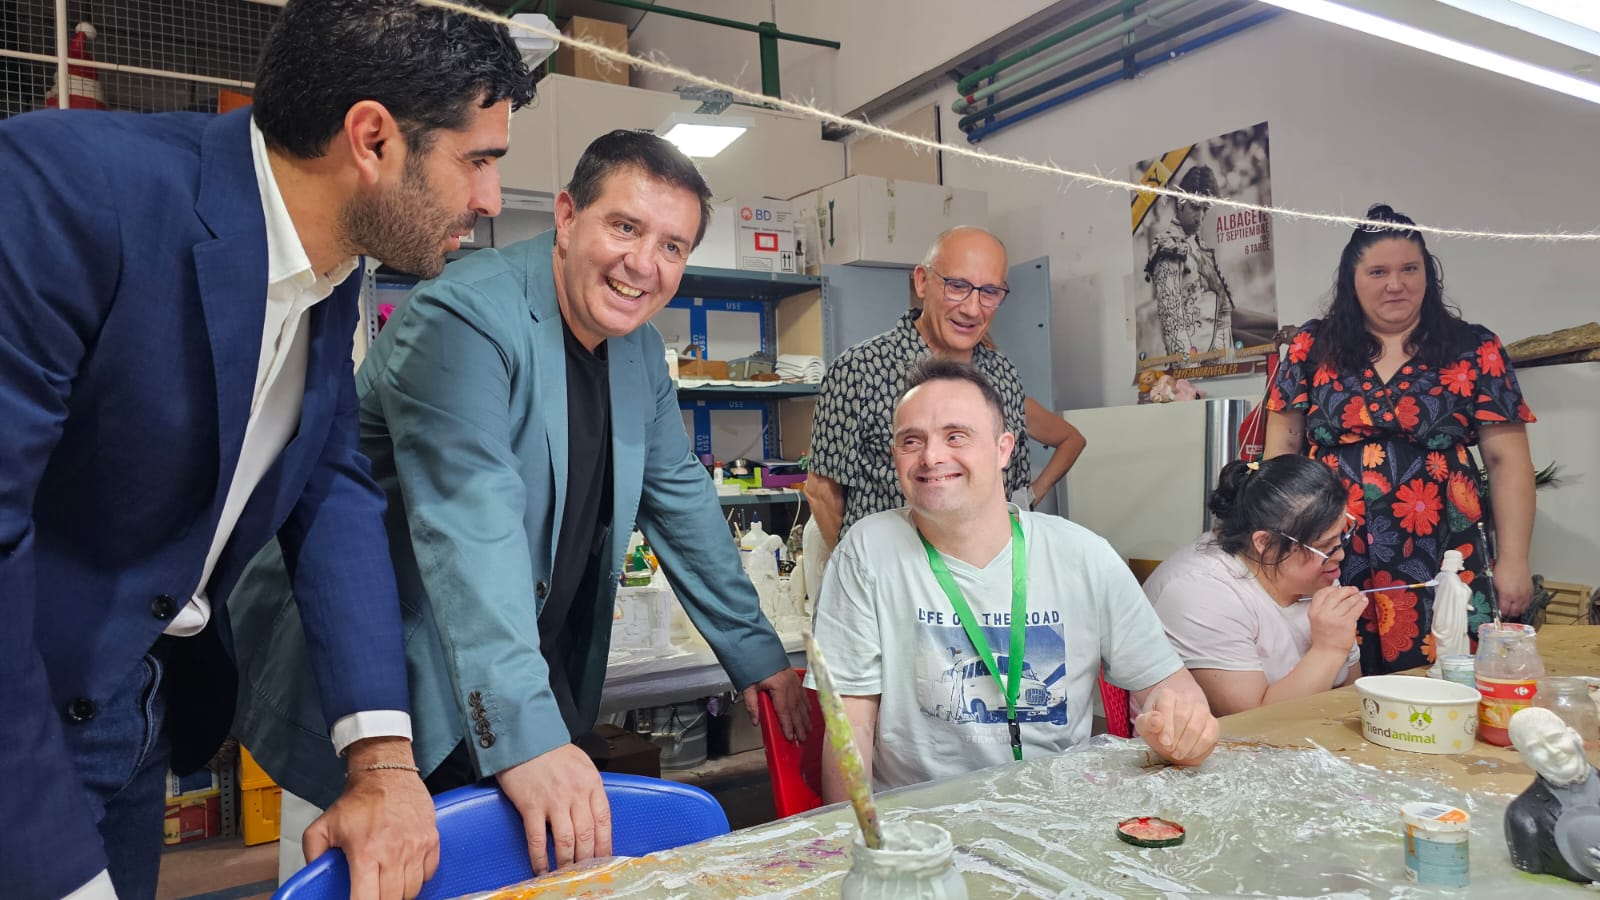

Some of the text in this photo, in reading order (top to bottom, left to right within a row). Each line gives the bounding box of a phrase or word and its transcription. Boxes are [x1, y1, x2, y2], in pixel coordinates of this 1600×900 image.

[755, 208, 772, 222] BD
[1226, 222, 1270, 242] SEPTIEMBRE
[982, 612, 1011, 626] THE
[1366, 721, 1437, 744] Tiendanimal
